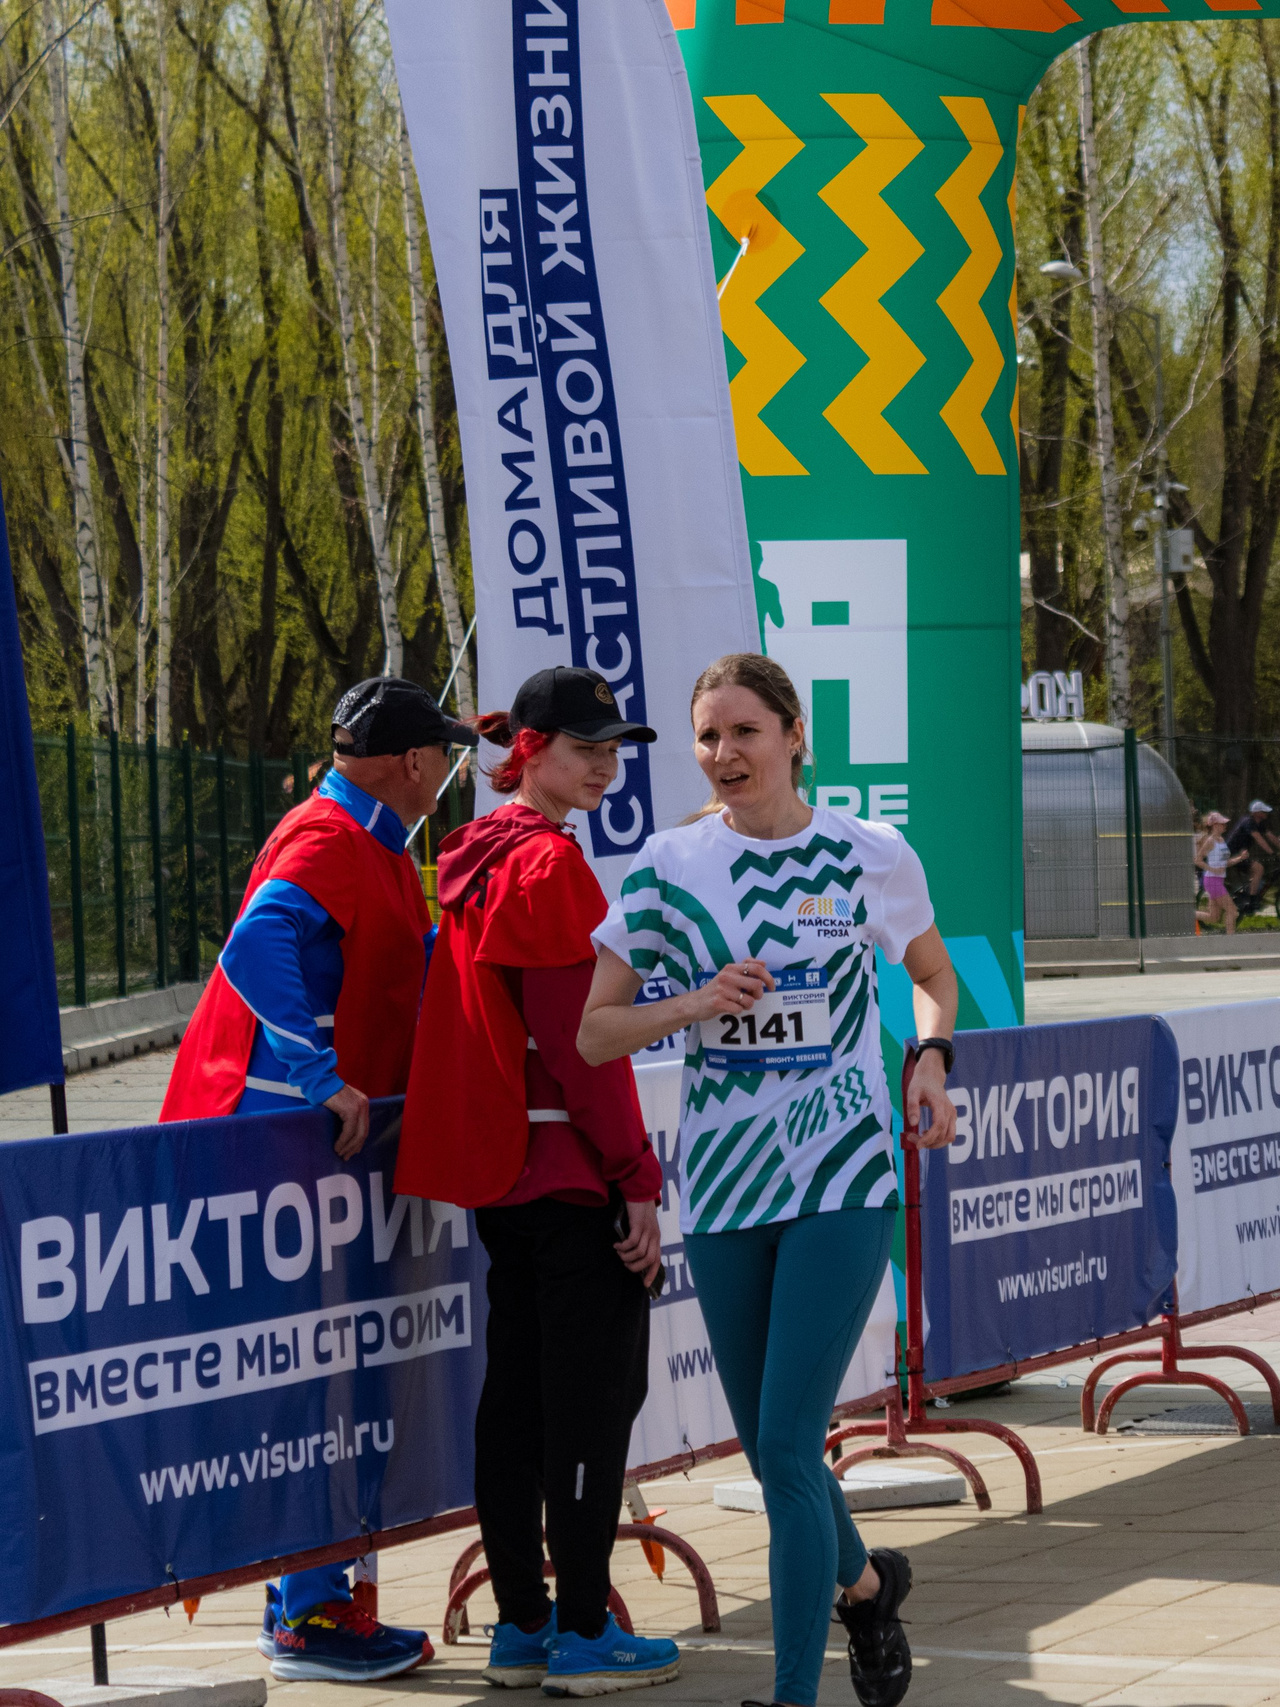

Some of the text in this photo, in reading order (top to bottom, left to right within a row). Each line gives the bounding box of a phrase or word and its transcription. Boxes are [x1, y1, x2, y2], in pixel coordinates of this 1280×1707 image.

[480, 197, 564, 637] ДОМА ДЛЯ
[798, 916, 851, 927] МАЙСКАЯ
[818, 929, 849, 938] ГРОЗА
[783, 993, 825, 1001] ВИКТОРИЯ
[719, 1011, 803, 1045] 2141
[947, 1066, 1139, 1164] ВИКТОРИЯ
[1192, 1145, 1260, 1186] вместе
[952, 1167, 1138, 1235] вместе мы строим
[20, 1172, 469, 1324] ВИКТОРИЯ
[998, 1251, 1107, 1302] www.visural.ru
[33, 1295, 465, 1421] вместе мы строим
[140, 1415, 395, 1505] www.visural.ru
[275, 1630, 306, 1650] HOKA
